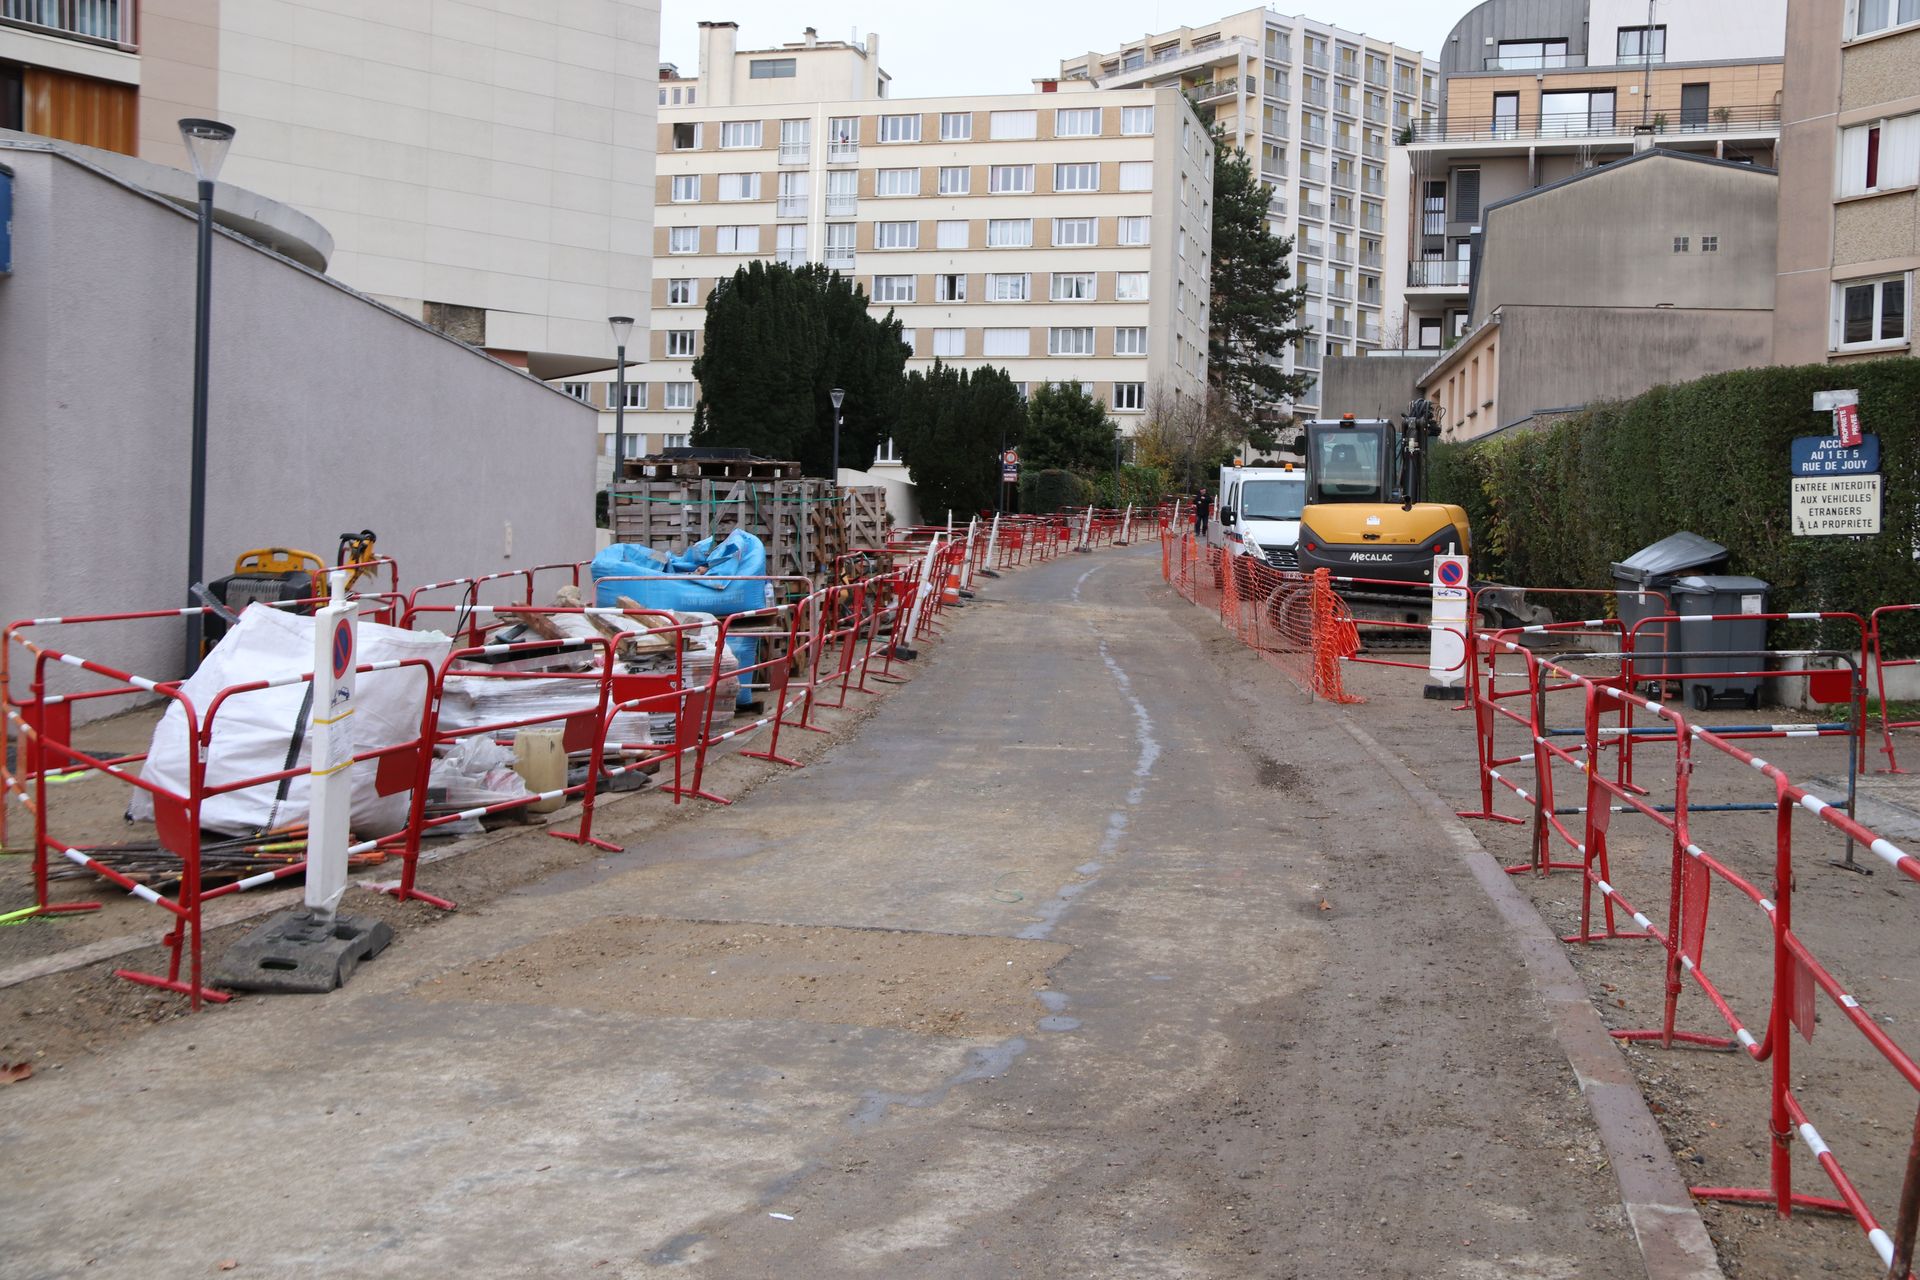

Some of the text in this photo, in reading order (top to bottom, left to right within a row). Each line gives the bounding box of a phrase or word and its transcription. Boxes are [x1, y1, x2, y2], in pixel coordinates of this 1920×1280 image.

[1811, 449, 1859, 460] AU 1 ET 5
[1802, 460, 1868, 471] RUE DE JOUY
[1795, 480, 1877, 492] ENTREE INTERDITE
[1800, 494, 1872, 504] AUX VEHICULES
[1808, 507, 1862, 517] ETRANGERS
[1808, 520, 1819, 529] LA
[1822, 519, 1873, 529] PROPRIETE
